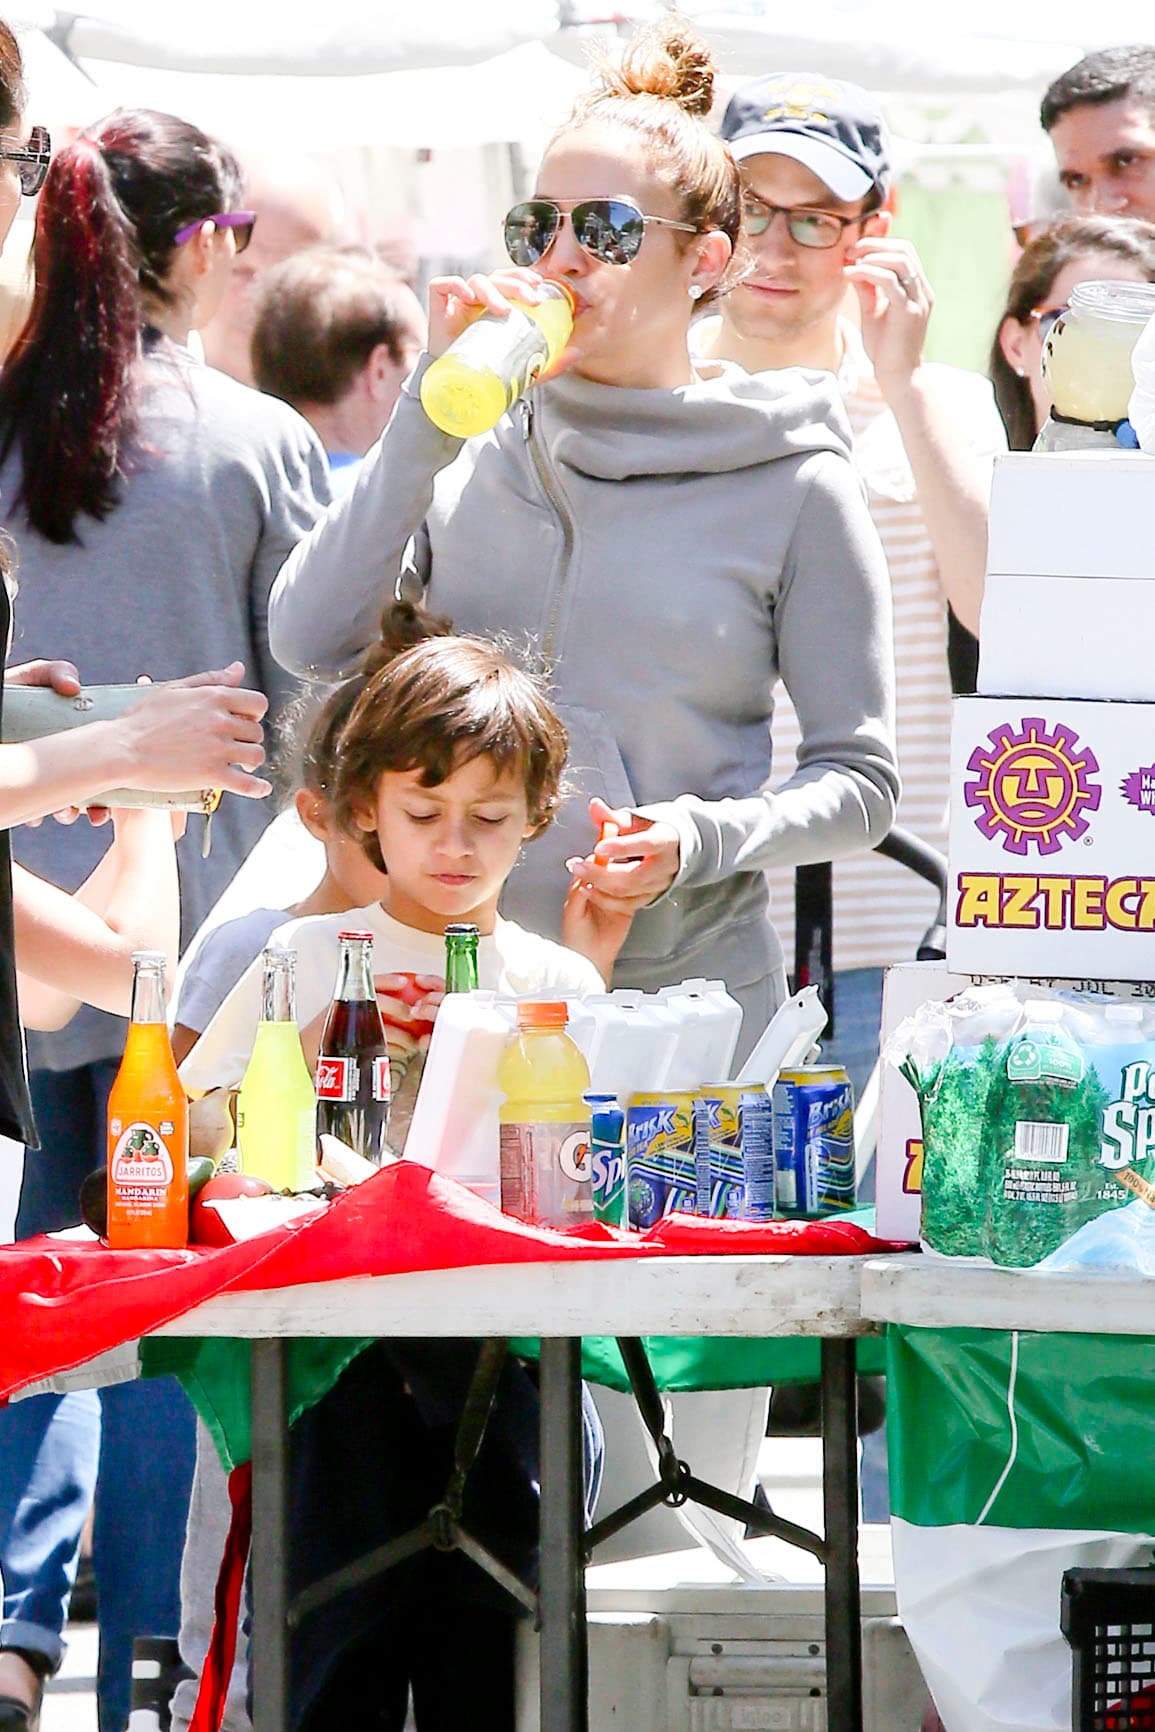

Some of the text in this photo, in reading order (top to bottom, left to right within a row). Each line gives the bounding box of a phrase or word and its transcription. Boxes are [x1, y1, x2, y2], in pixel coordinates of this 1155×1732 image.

[118, 1166, 162, 1177] JARRITOS
[115, 1187, 167, 1197] MANDARIN
[1096, 1190, 1126, 1200] 1845
